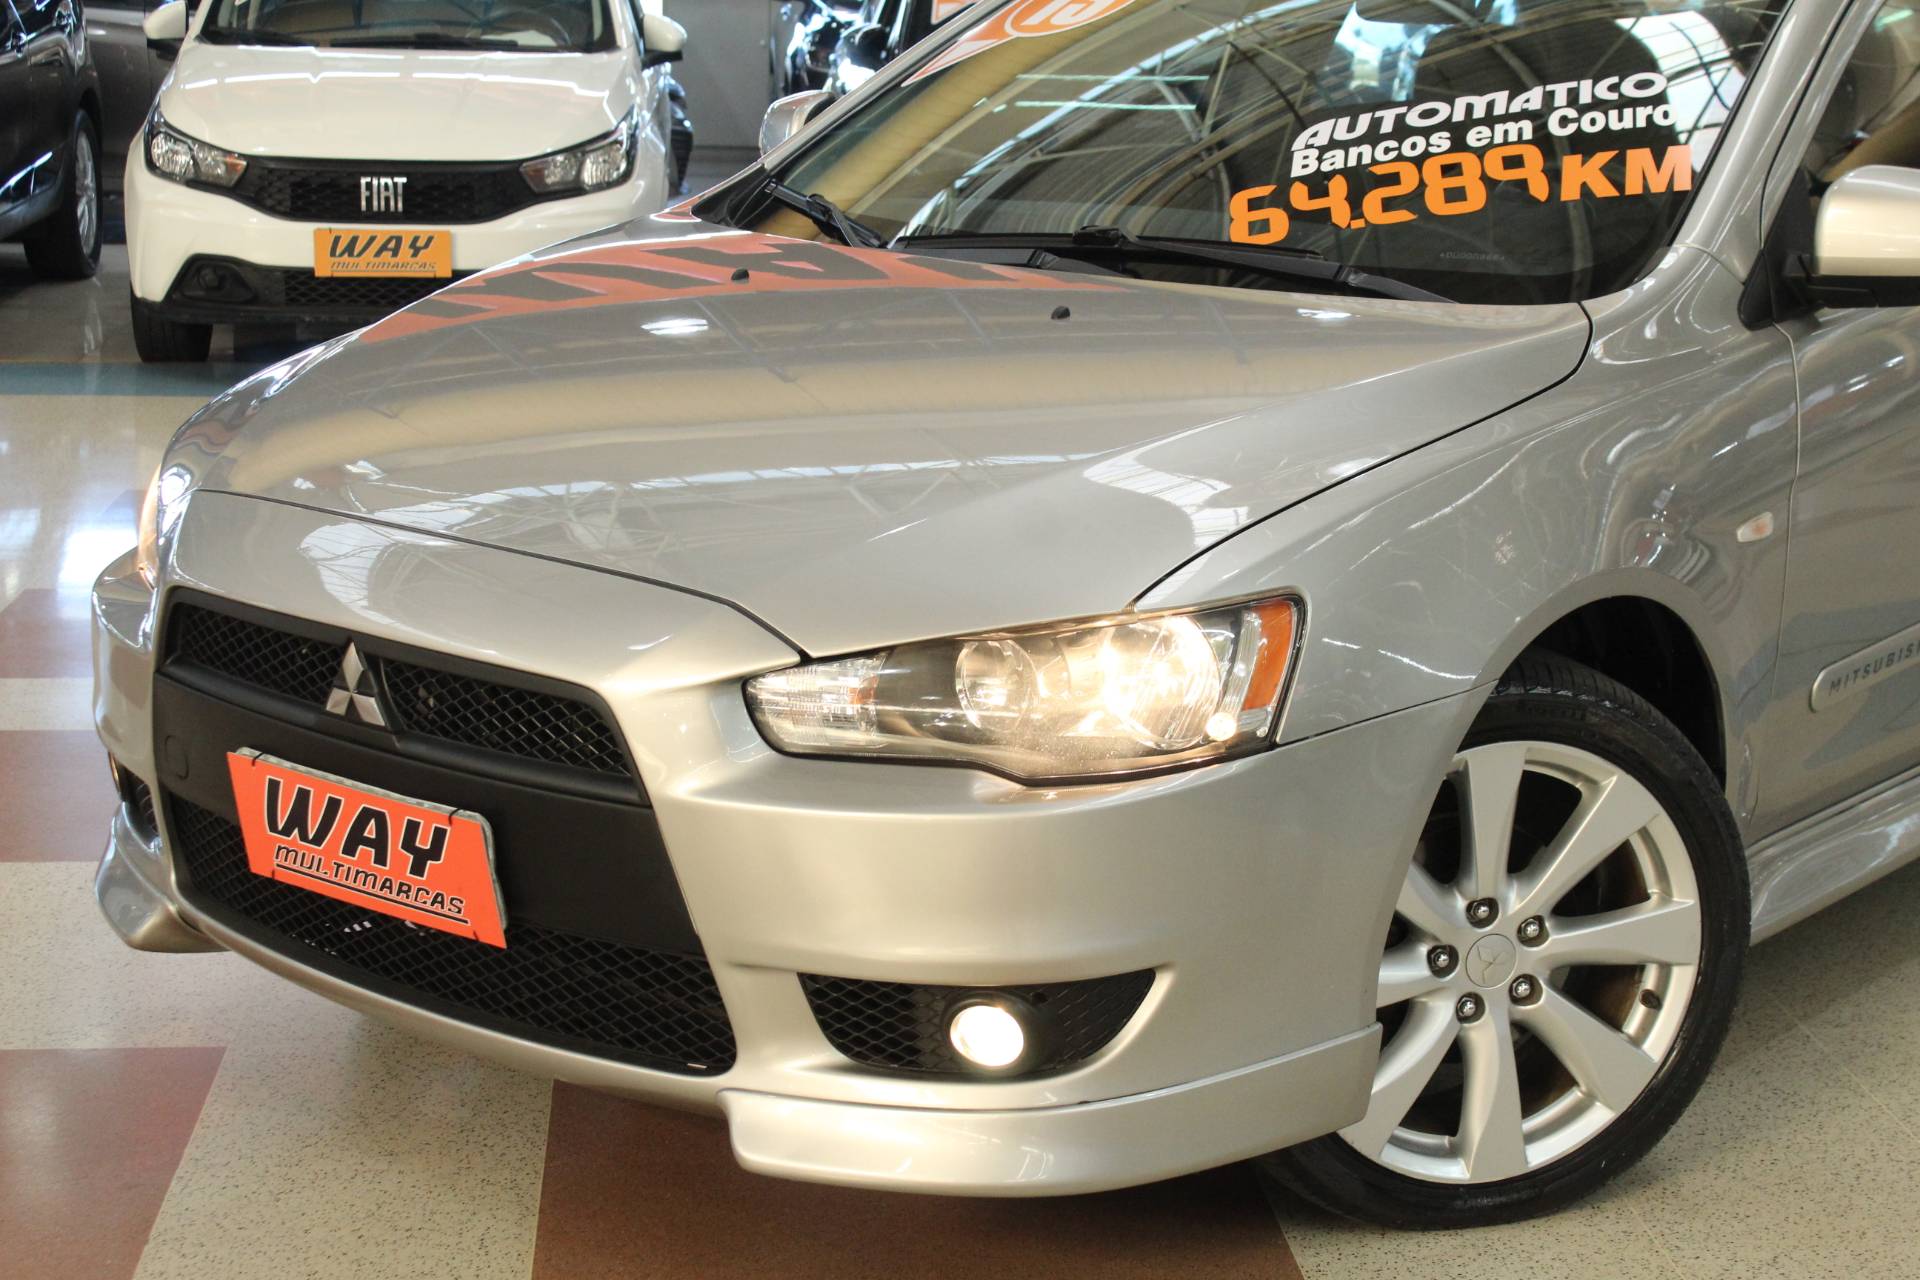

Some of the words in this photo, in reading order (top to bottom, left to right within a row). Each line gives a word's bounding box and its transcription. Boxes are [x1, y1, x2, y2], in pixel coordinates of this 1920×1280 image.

[1290, 130, 1452, 178] Bancos
[1466, 117, 1533, 146] em
[1548, 103, 1677, 137] Couro
[1291, 72, 1669, 152] AUTOMATICO
[360, 176, 408, 212] FIAT
[1560, 145, 1693, 201] KM
[329, 235, 434, 258] WAY
[331, 261, 437, 270] MULTIMARCAS
[264, 776, 451, 880] WAY
[274, 844, 465, 916] MULTIMARCAS
